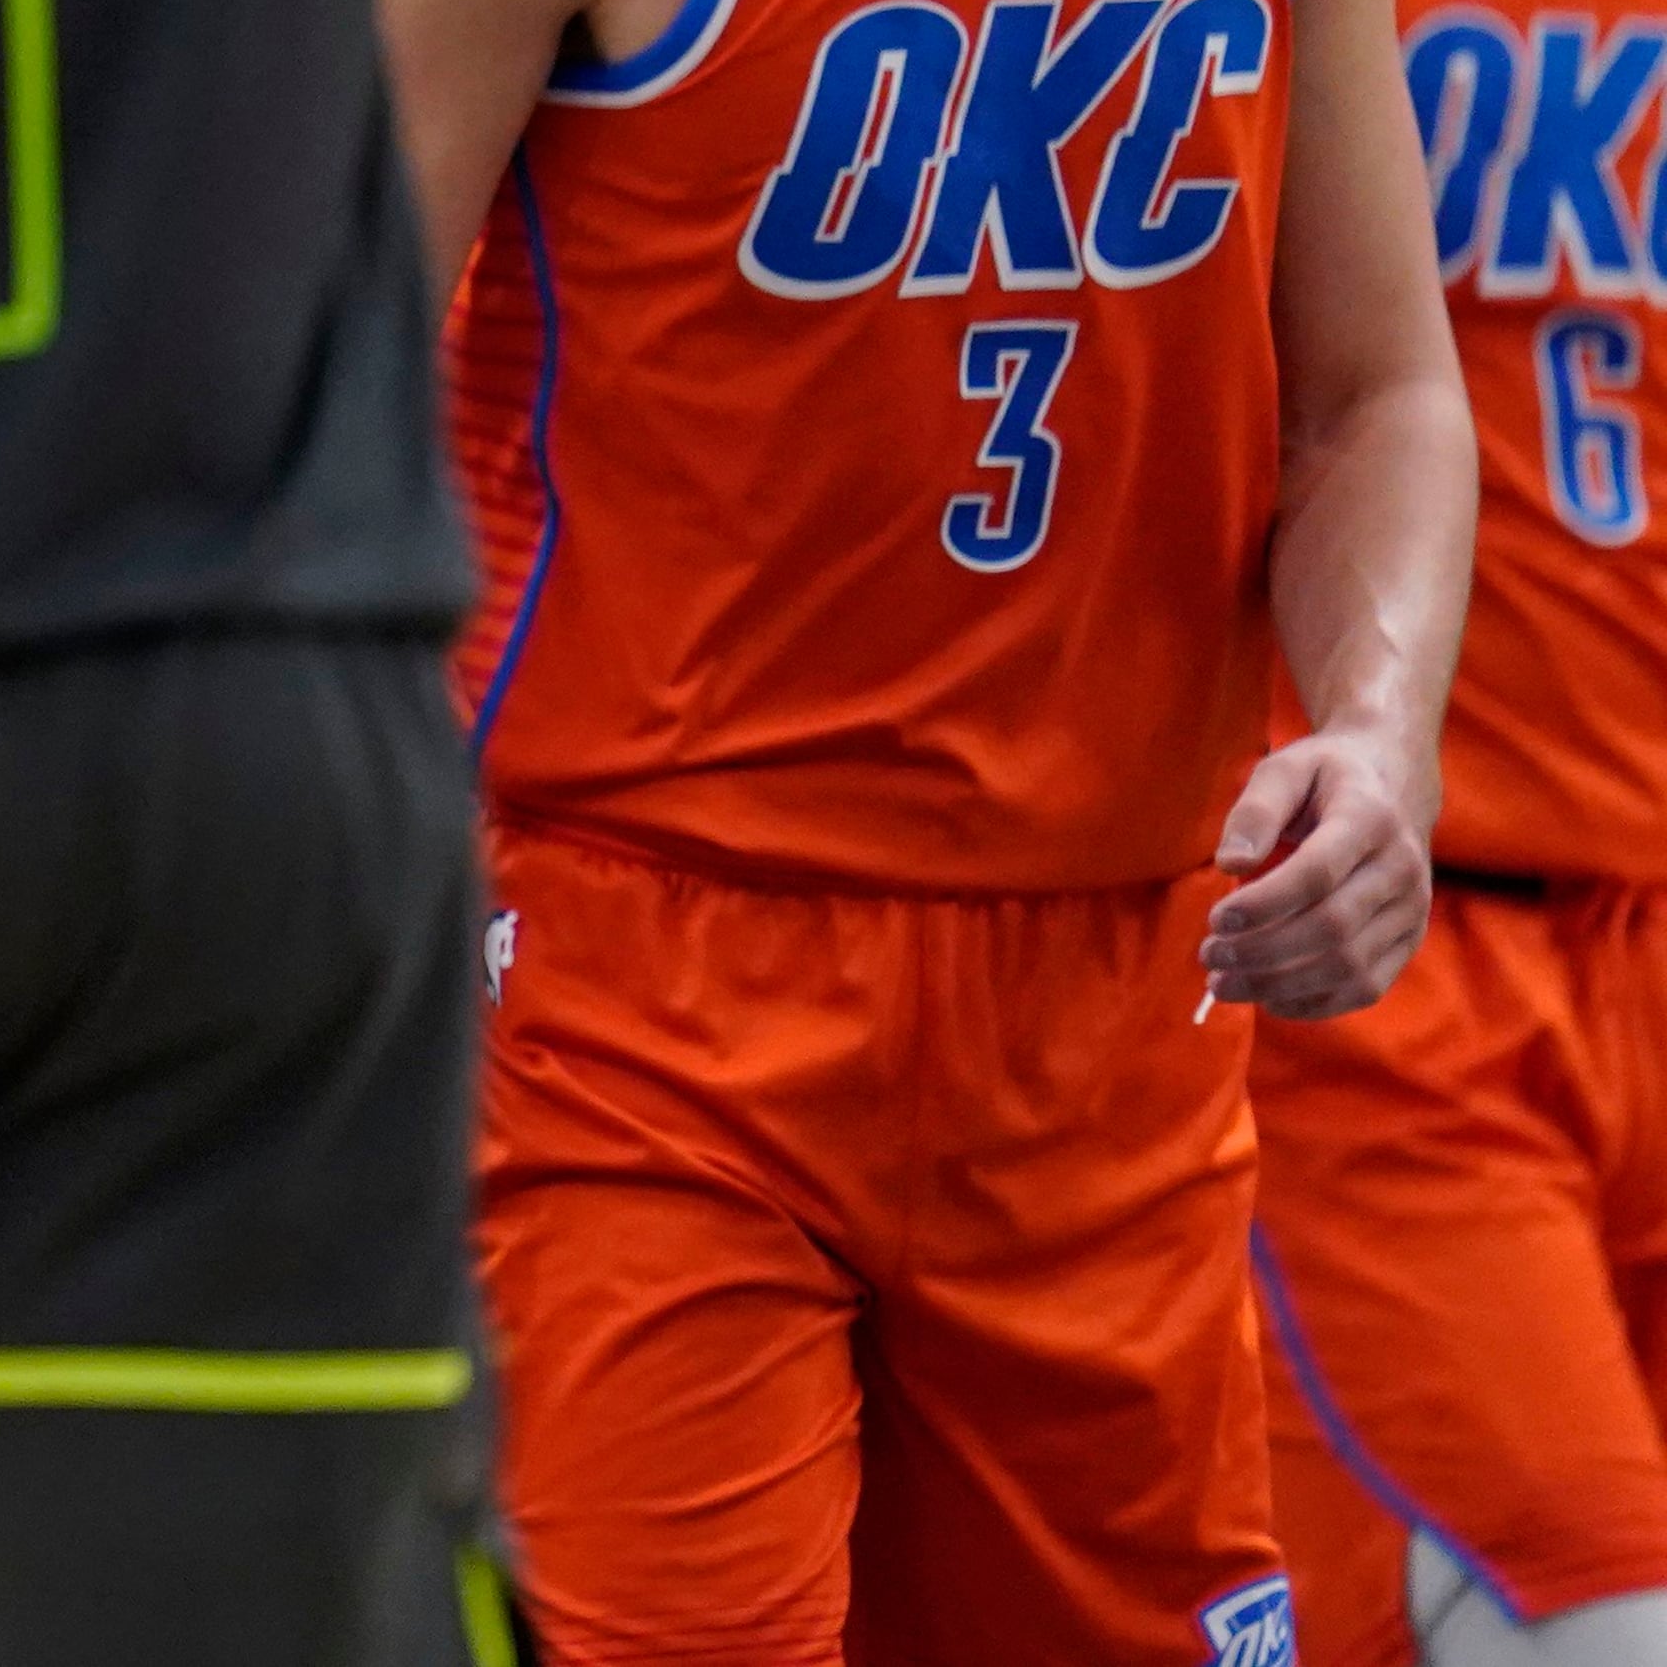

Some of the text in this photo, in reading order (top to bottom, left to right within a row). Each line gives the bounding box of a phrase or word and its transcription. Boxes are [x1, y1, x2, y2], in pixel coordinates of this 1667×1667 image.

[1400, 1, 1667, 305] OK
[941, 319, 1079, 573] 3
[1534, 304, 1648, 548] 6
